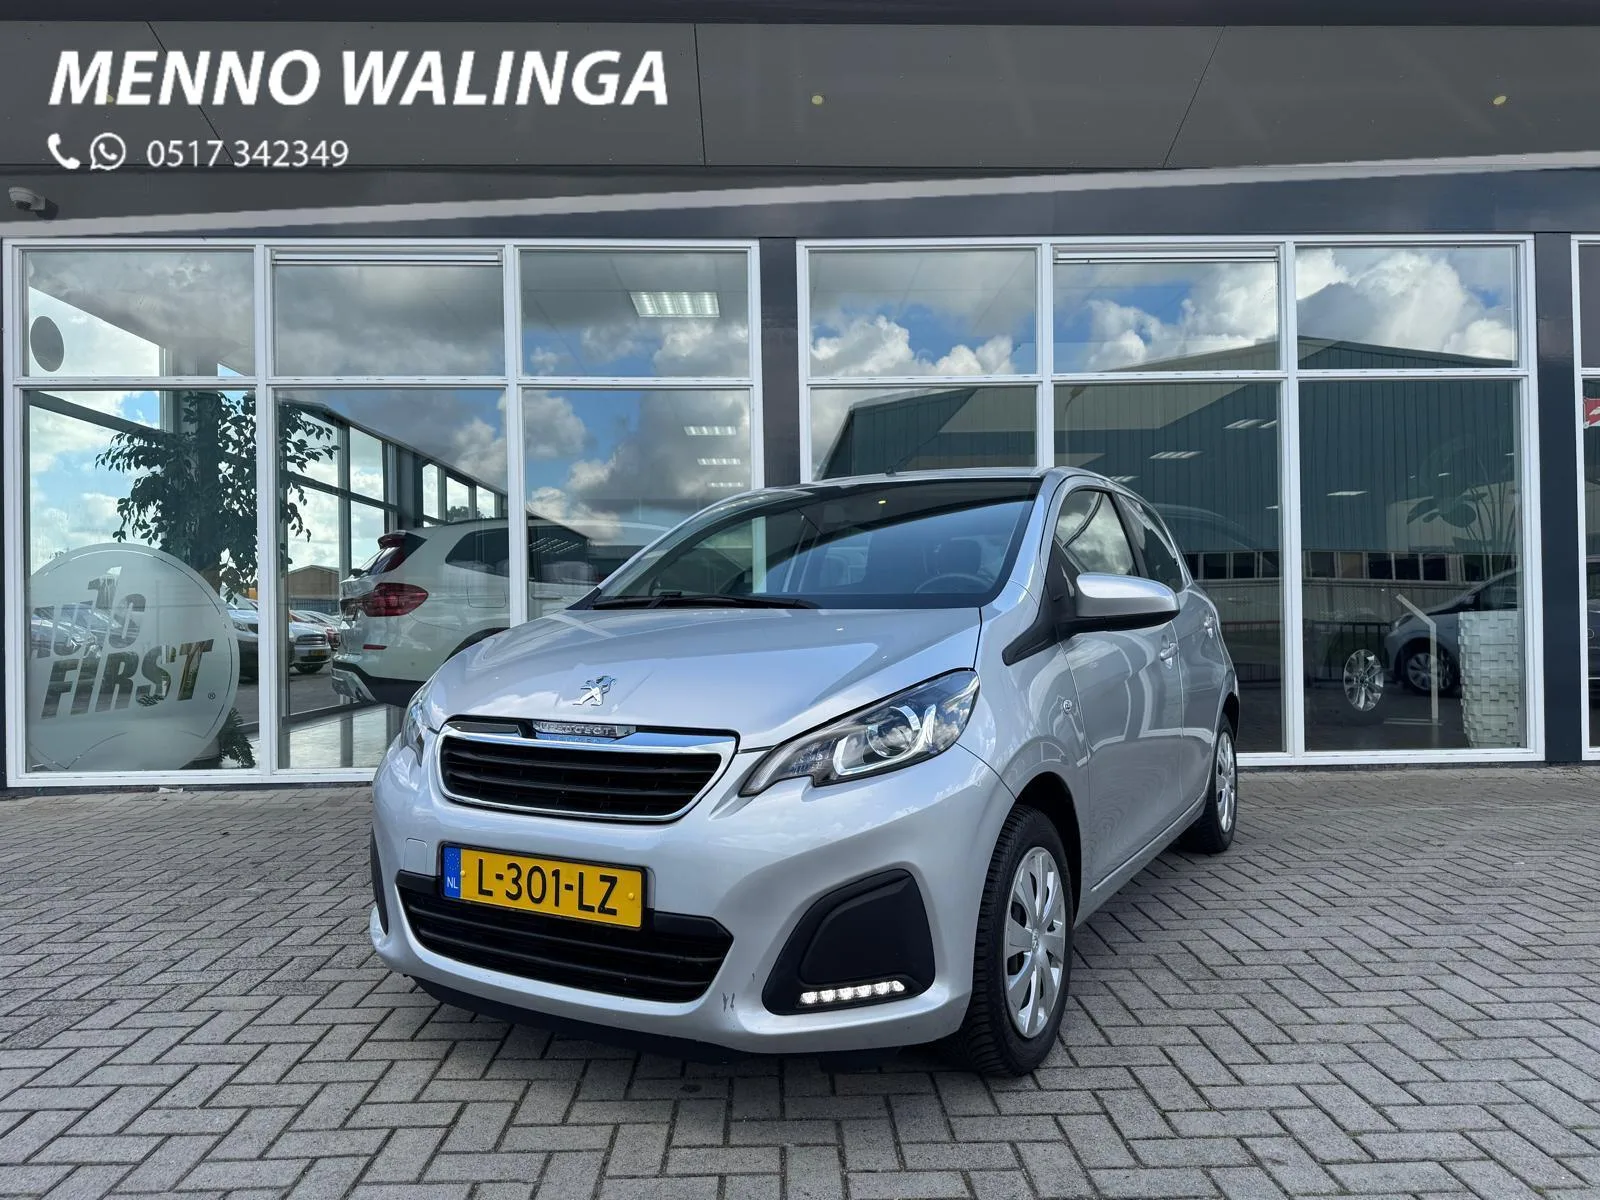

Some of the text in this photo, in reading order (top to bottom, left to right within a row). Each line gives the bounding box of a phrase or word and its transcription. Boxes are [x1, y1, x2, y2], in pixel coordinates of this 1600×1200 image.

[41, 639, 214, 720] FIRST
[446, 876, 459, 889] NL
[478, 858, 618, 916] L-301-LZ
